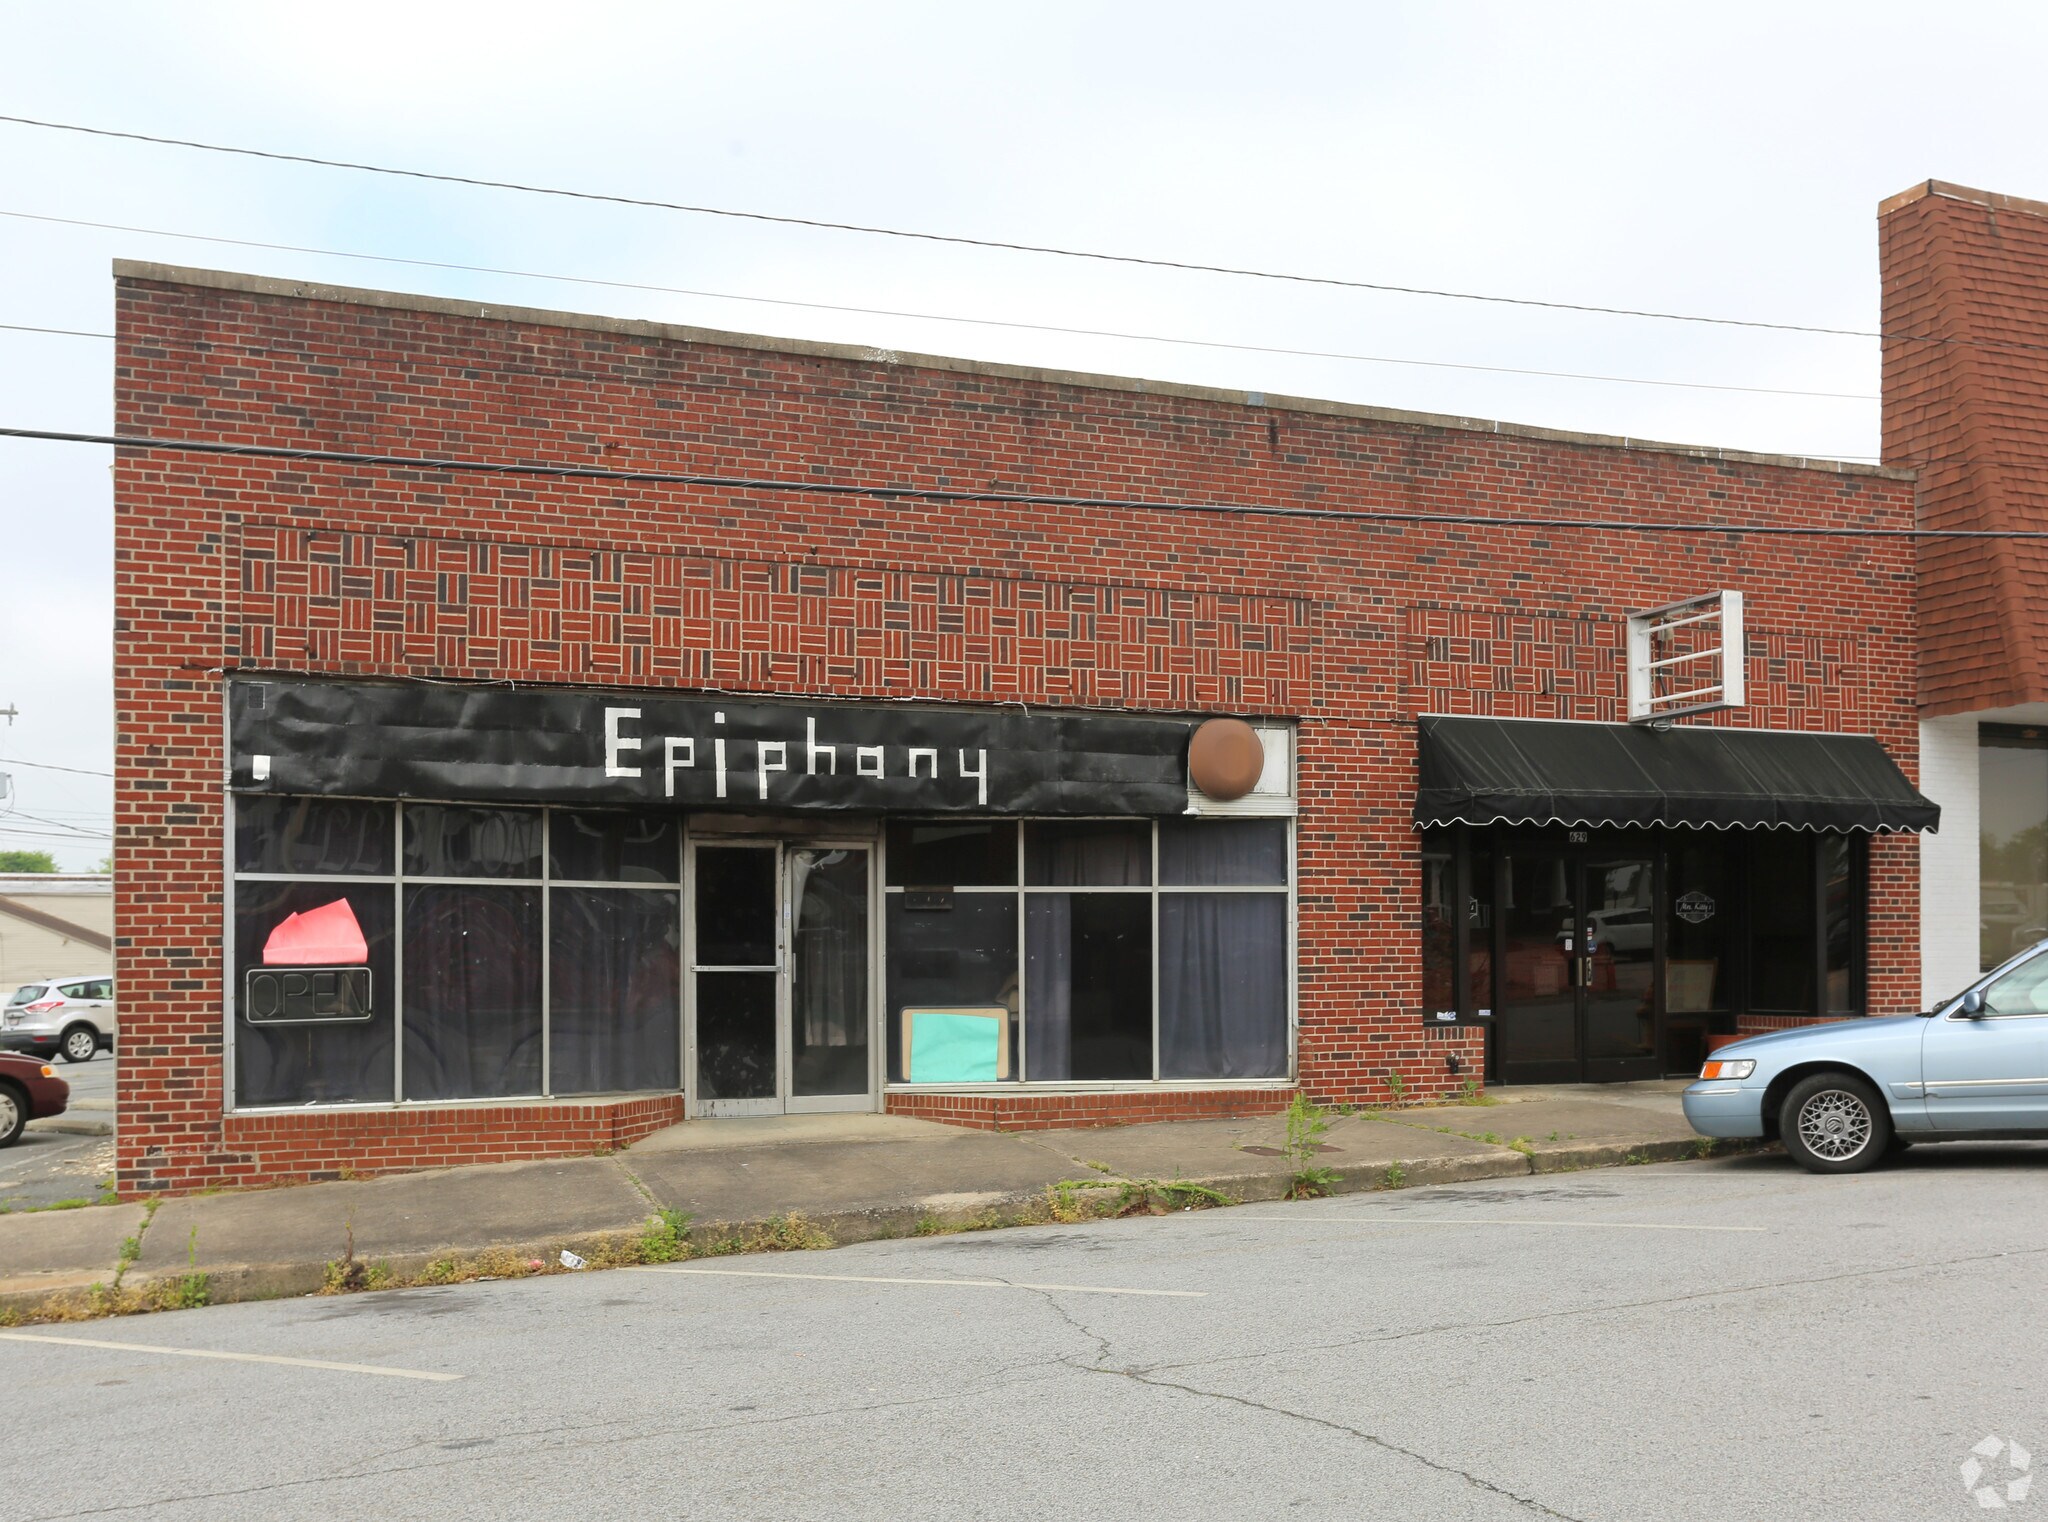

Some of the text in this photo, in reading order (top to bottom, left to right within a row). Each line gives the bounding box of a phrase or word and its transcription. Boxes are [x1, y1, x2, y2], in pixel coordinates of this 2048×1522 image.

[605, 707, 987, 805] Epiphany
[1570, 832, 1587, 842] 629
[252, 973, 365, 1017] OPEN
